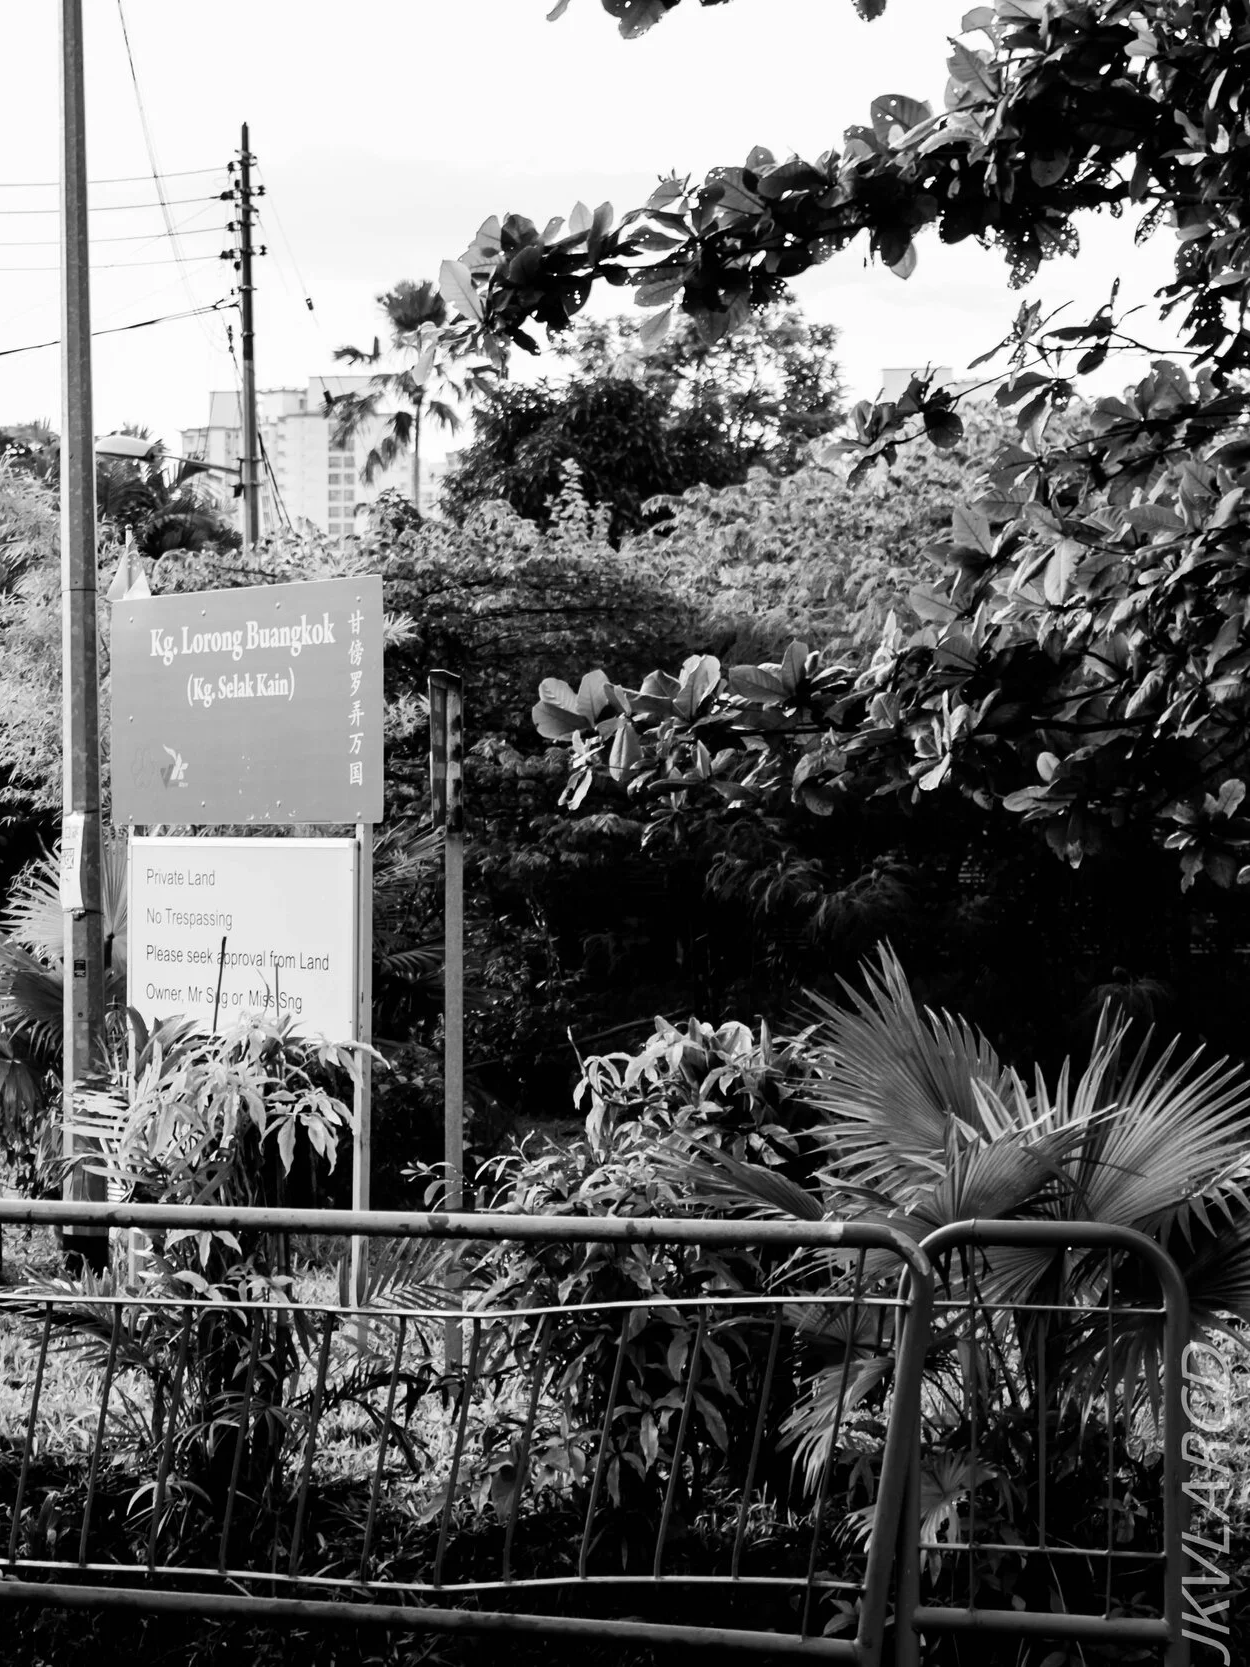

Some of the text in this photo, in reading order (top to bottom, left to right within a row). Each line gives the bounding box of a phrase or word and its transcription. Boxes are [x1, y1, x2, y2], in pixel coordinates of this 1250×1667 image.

[150, 612, 336, 666] Kg. Lorong Buangkok
[187, 667, 295, 708] (Kg. Selak Kain)
[146, 868, 216, 886] Private Land
[146, 907, 232, 931] No Trespassing
[146, 944, 329, 971] Please seek approval from Land
[146, 983, 184, 1003] Owner,
[188, 986, 203, 1002] Mr
[232, 992, 243, 1006] or
[249, 990, 275, 1008] Miss
[278, 991, 302, 1014] Sng
